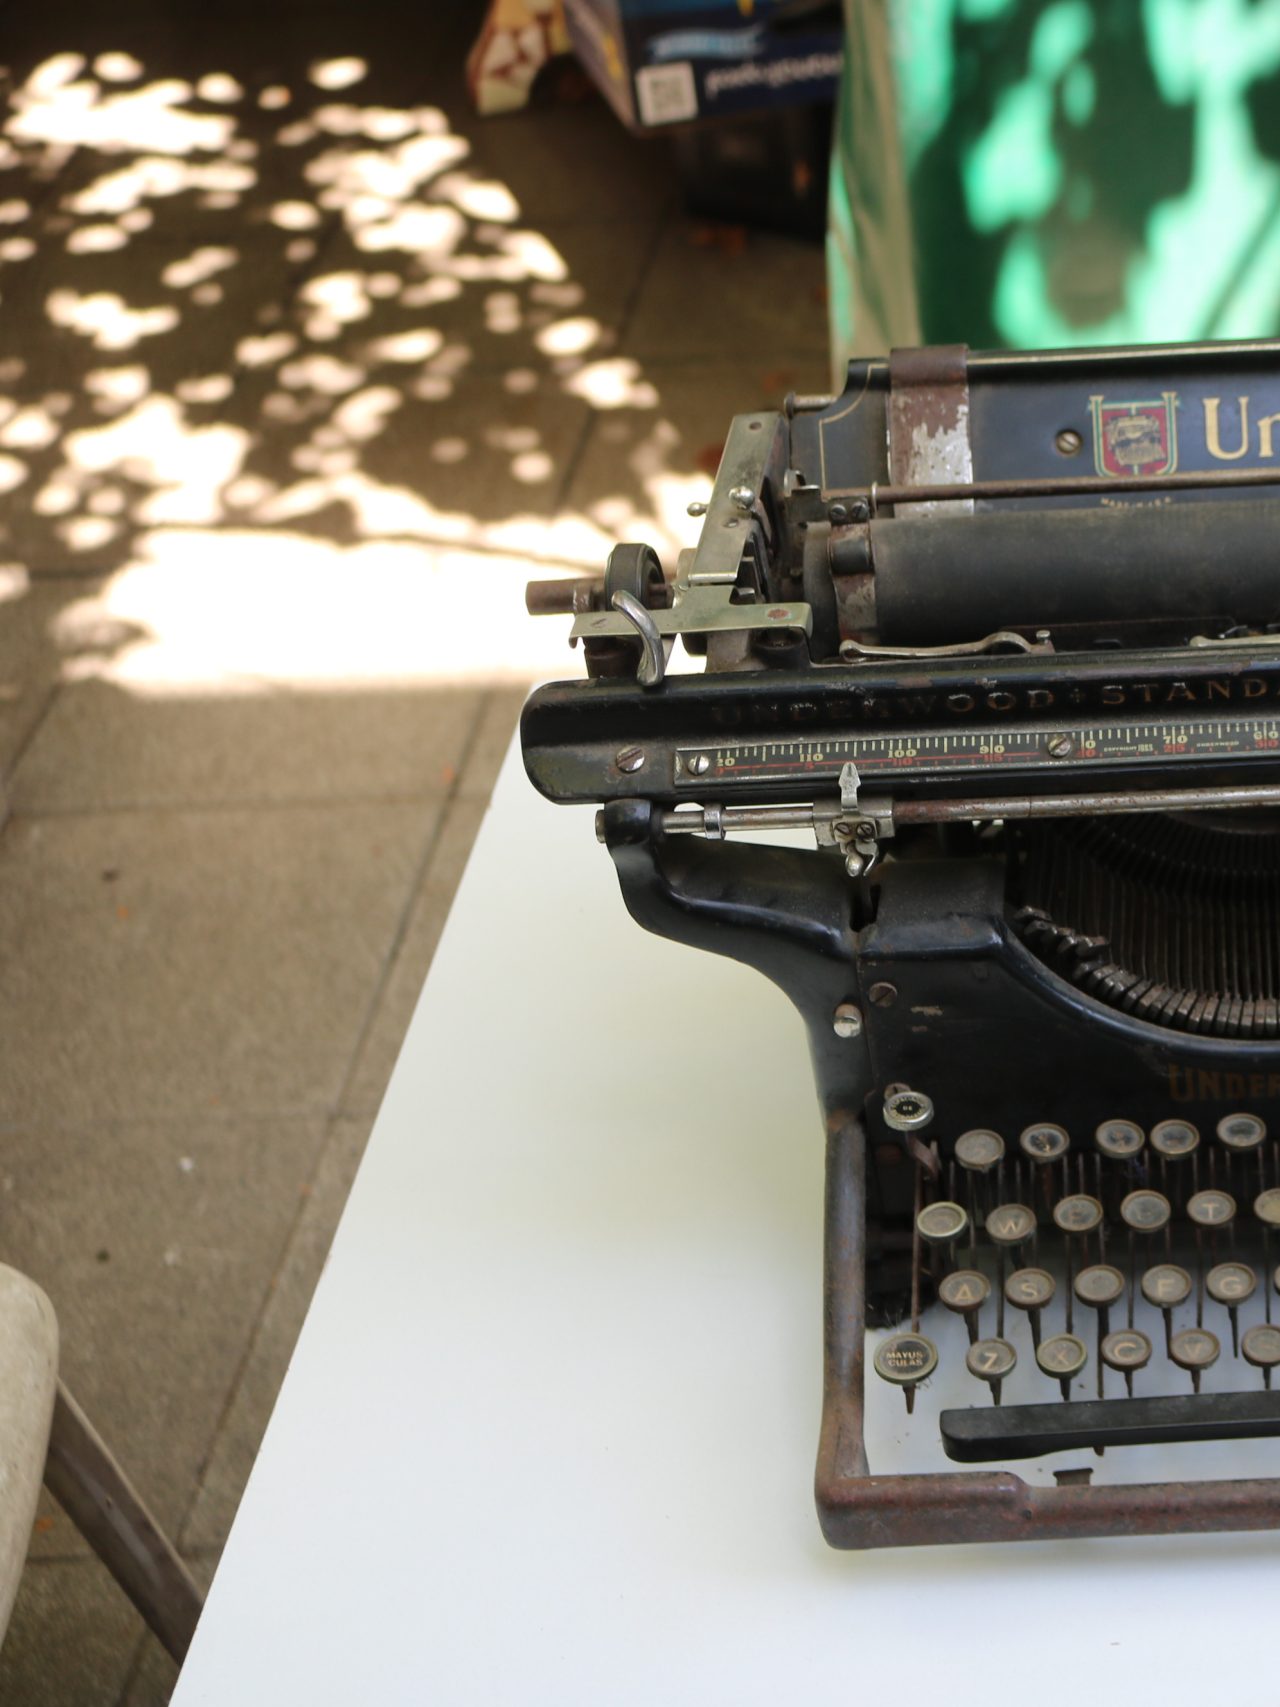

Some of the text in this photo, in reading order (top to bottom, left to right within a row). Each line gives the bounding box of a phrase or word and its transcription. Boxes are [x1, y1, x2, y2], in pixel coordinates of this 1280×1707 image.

[887, 748, 918, 759] 100
[979, 744, 1006, 755] 90
[1162, 734, 1189, 745] 70
[1253, 730, 1280, 740] 60
[1201, 1202, 1220, 1220] T
[954, 1283, 974, 1301] A
[1020, 1282, 1039, 1299] S
[1156, 1278, 1176, 1297] F
[1220, 1276, 1243, 1295] G
[1113, 1341, 1138, 1360] C
[1183, 1342, 1204, 1360] V
